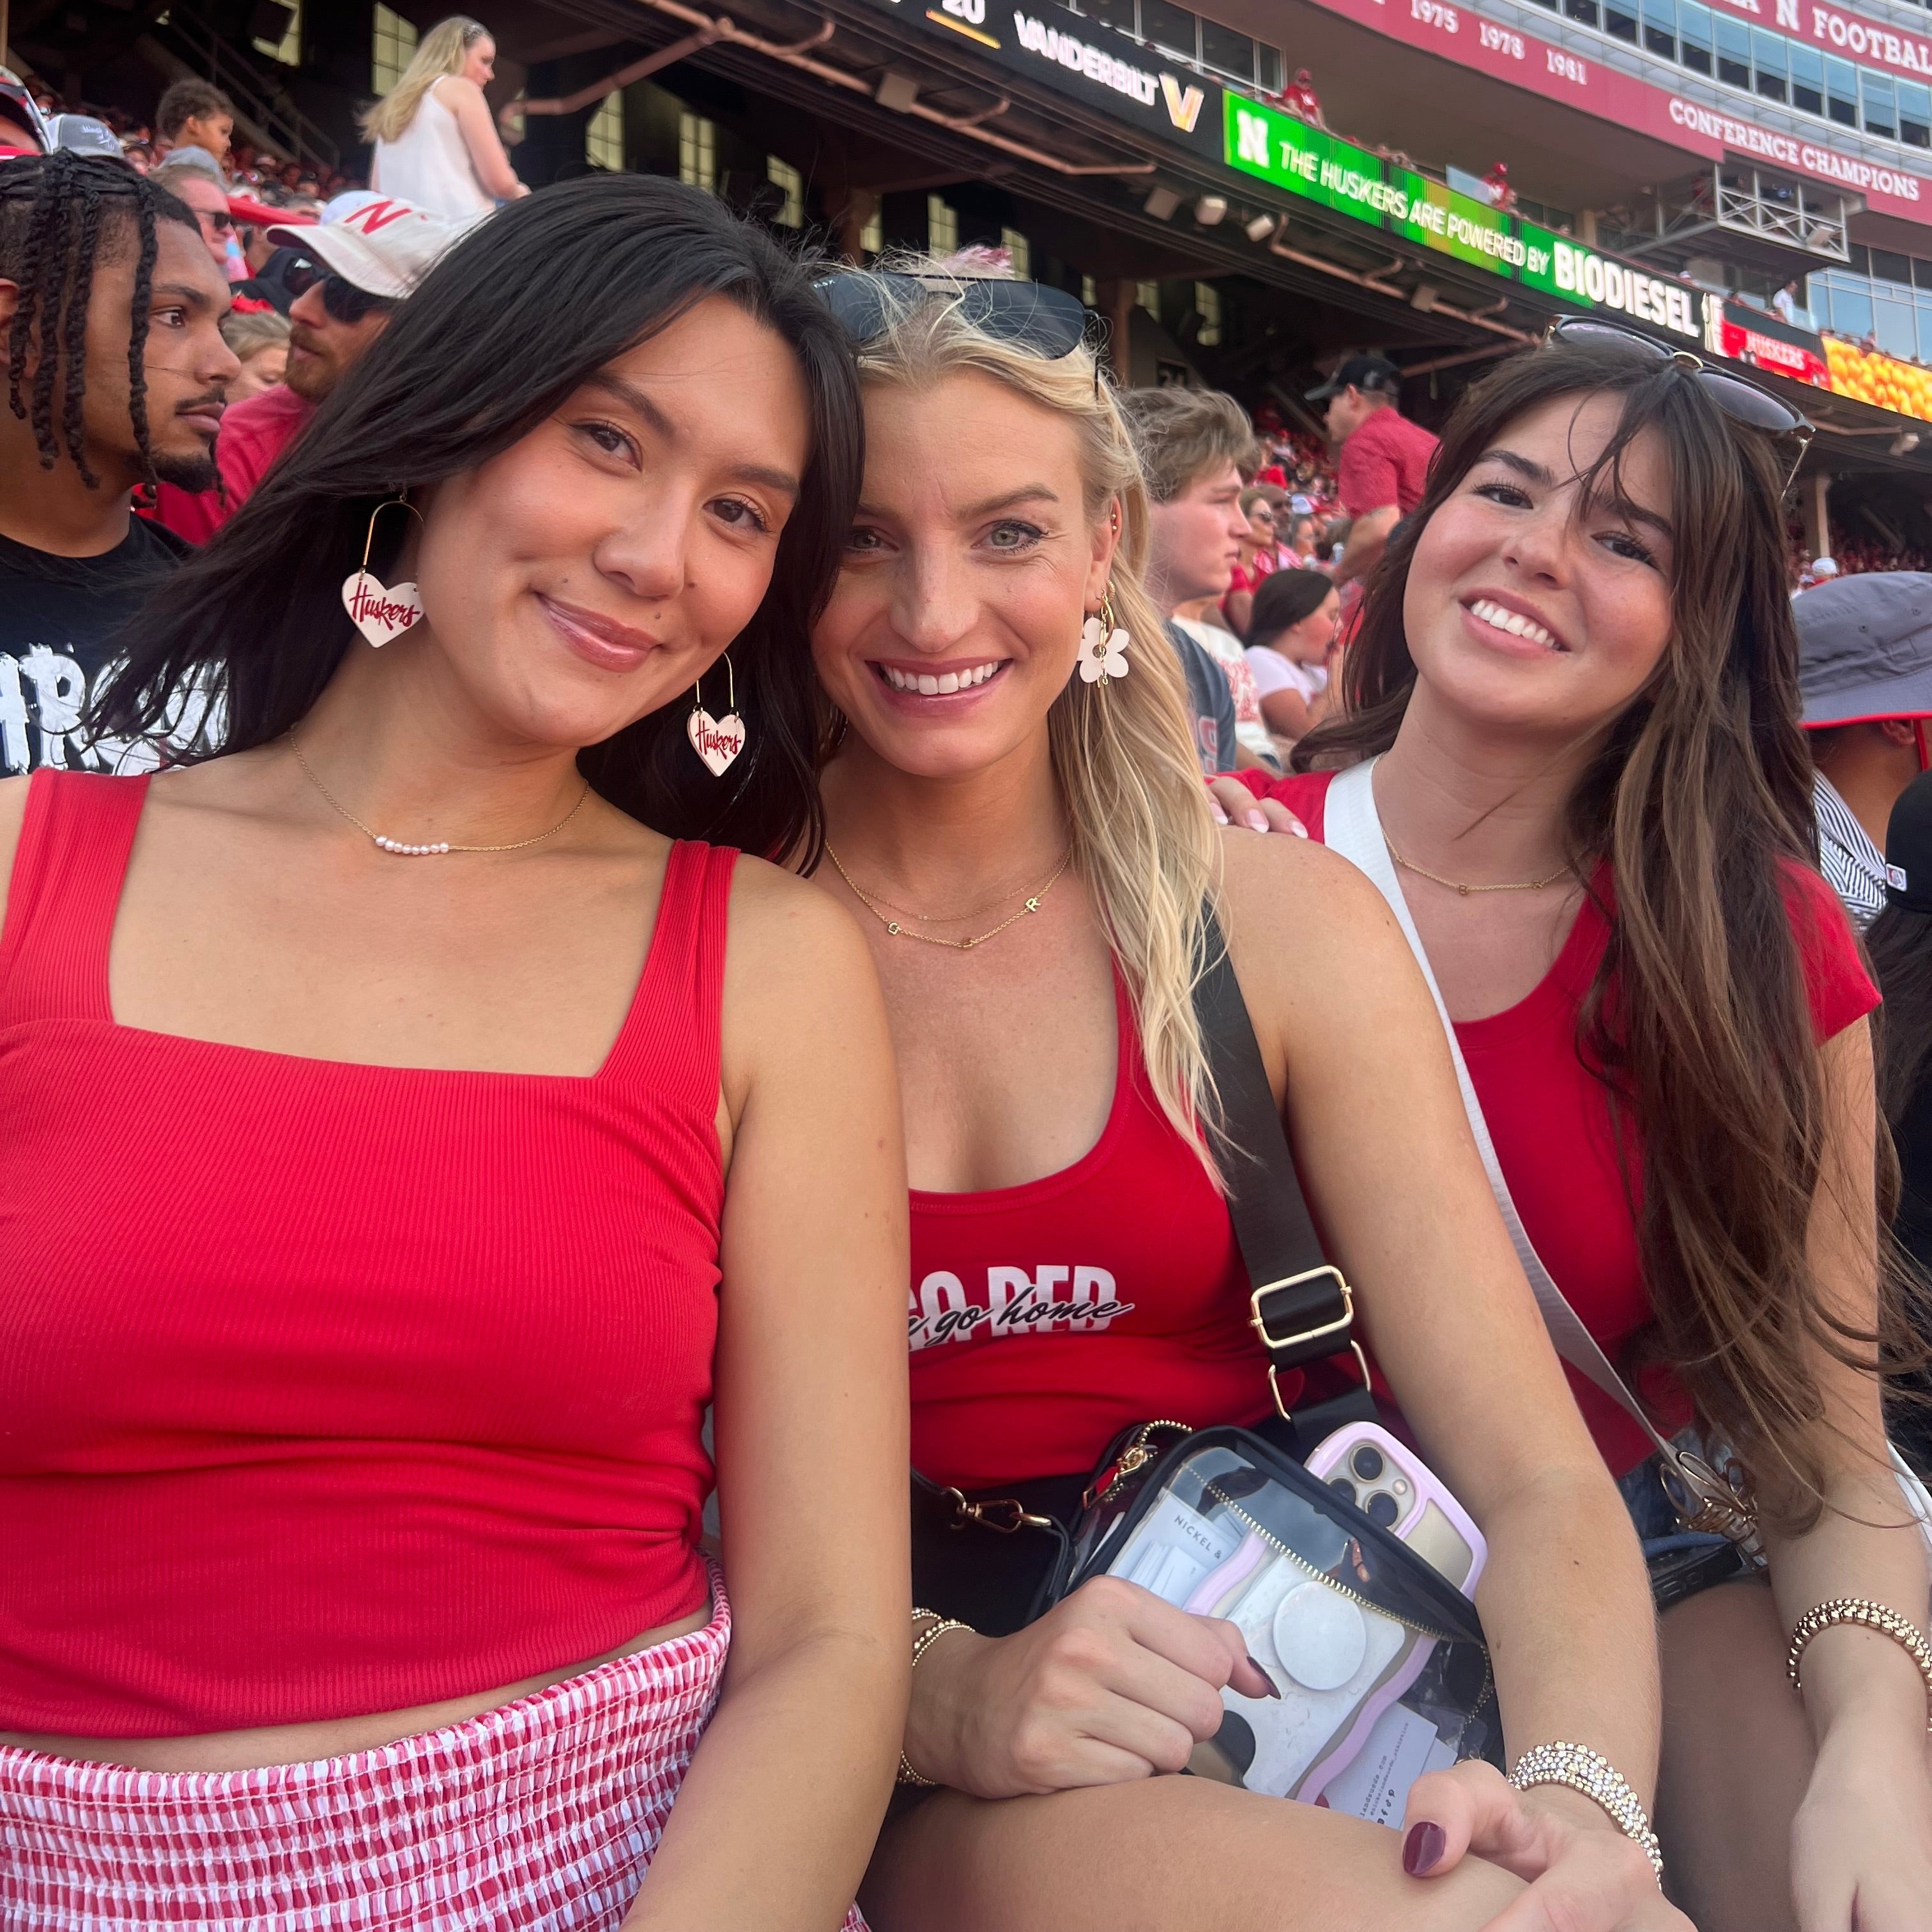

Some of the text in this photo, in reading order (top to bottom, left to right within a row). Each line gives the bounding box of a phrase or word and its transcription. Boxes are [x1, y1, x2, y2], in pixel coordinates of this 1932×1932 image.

[1411, 0, 1587, 85] 1975 1978 1981
[1775, 0, 1800, 33] N
[1015, 10, 1159, 106] VANDERBILT
[1669, 98, 1920, 201] CONFERENCE CHAMPIONS
[1236, 109, 1701, 337] N THE HUSKERS ARE POWERED BY BIODIESEL
[349, 581, 420, 631] Huskers
[695, 719, 741, 760] Huskers
[909, 1264, 1116, 1352] O RED
[924, 1310, 993, 1347] go
[997, 1285, 1135, 1326] home
[1174, 1515, 1211, 1551] NICKEL
